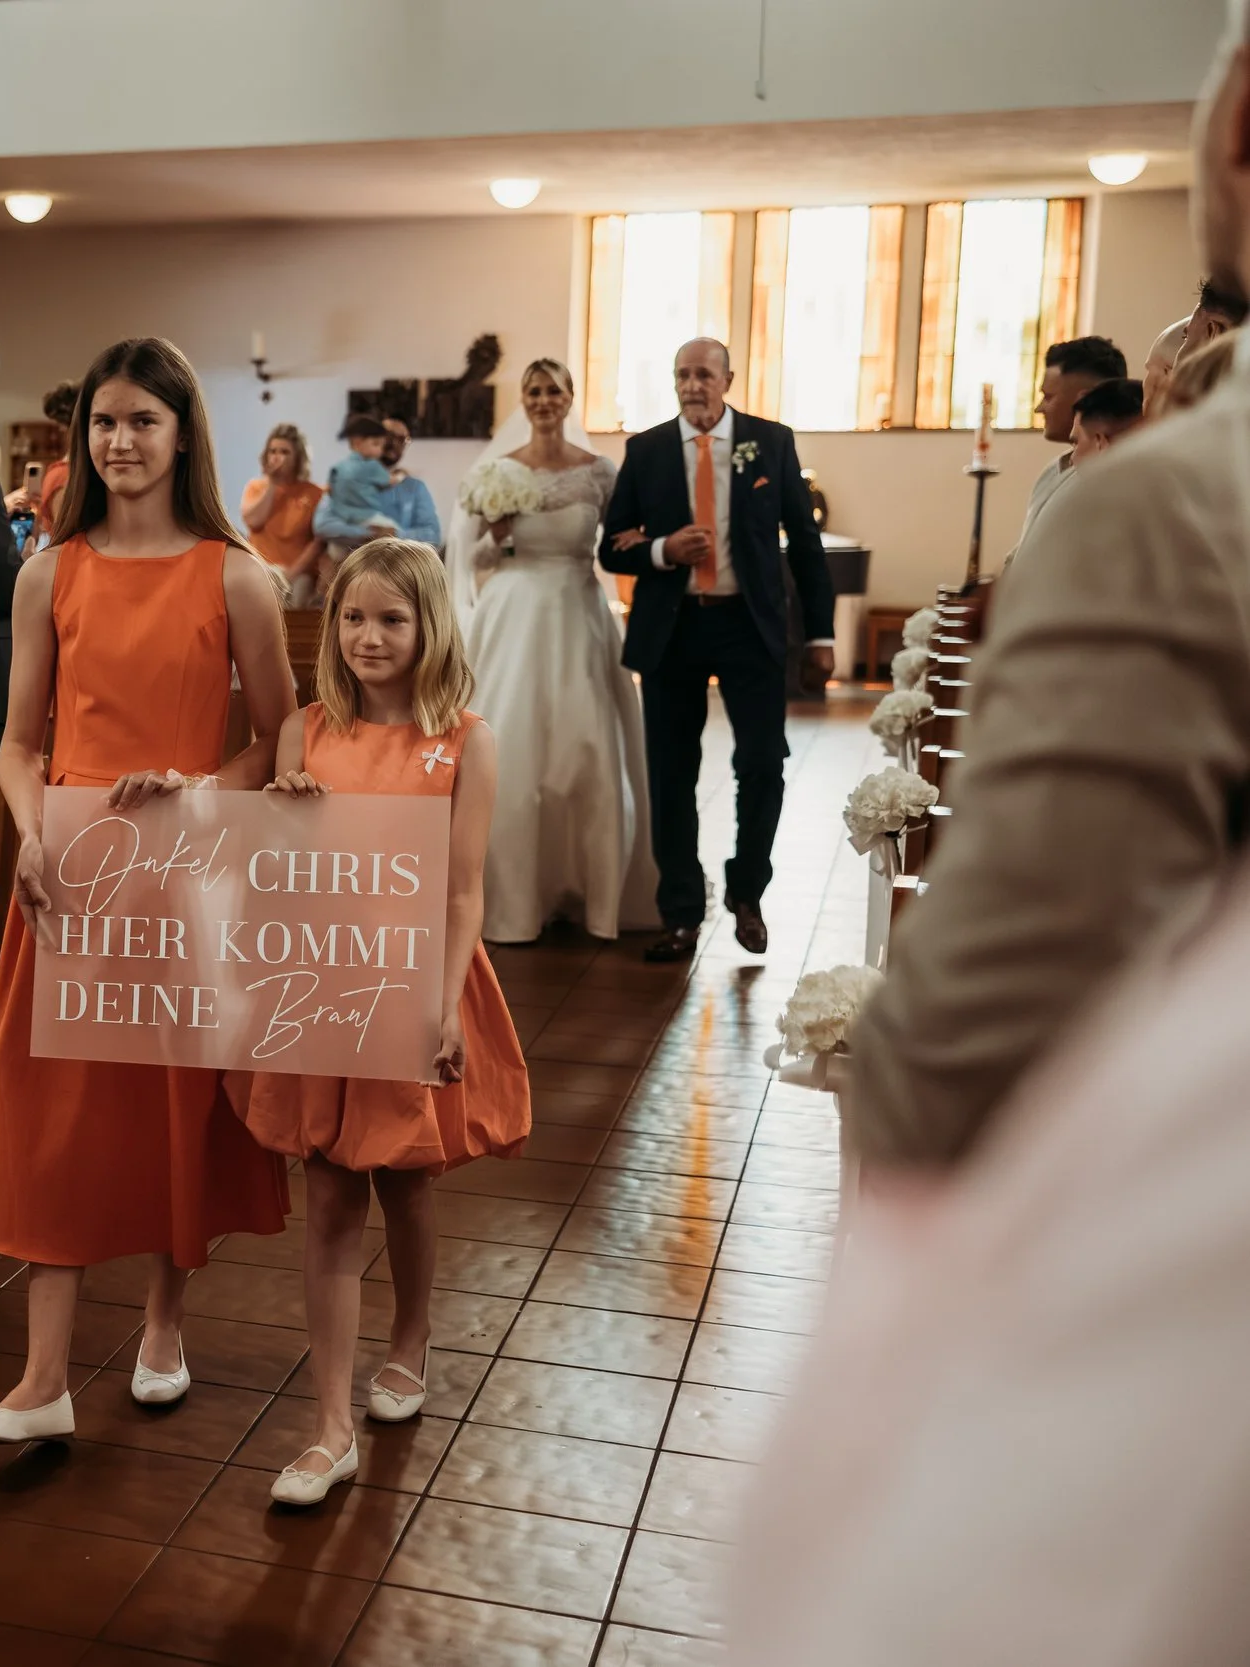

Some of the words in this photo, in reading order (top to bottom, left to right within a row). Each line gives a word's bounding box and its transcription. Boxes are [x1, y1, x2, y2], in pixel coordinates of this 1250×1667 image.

[58, 816, 228, 915] Onkel
[248, 849, 420, 897] CHRIS
[56, 914, 188, 960] HIER
[214, 920, 429, 970] KOMMT
[55, 980, 219, 1029] DEINE
[245, 971, 409, 1059] Braut
